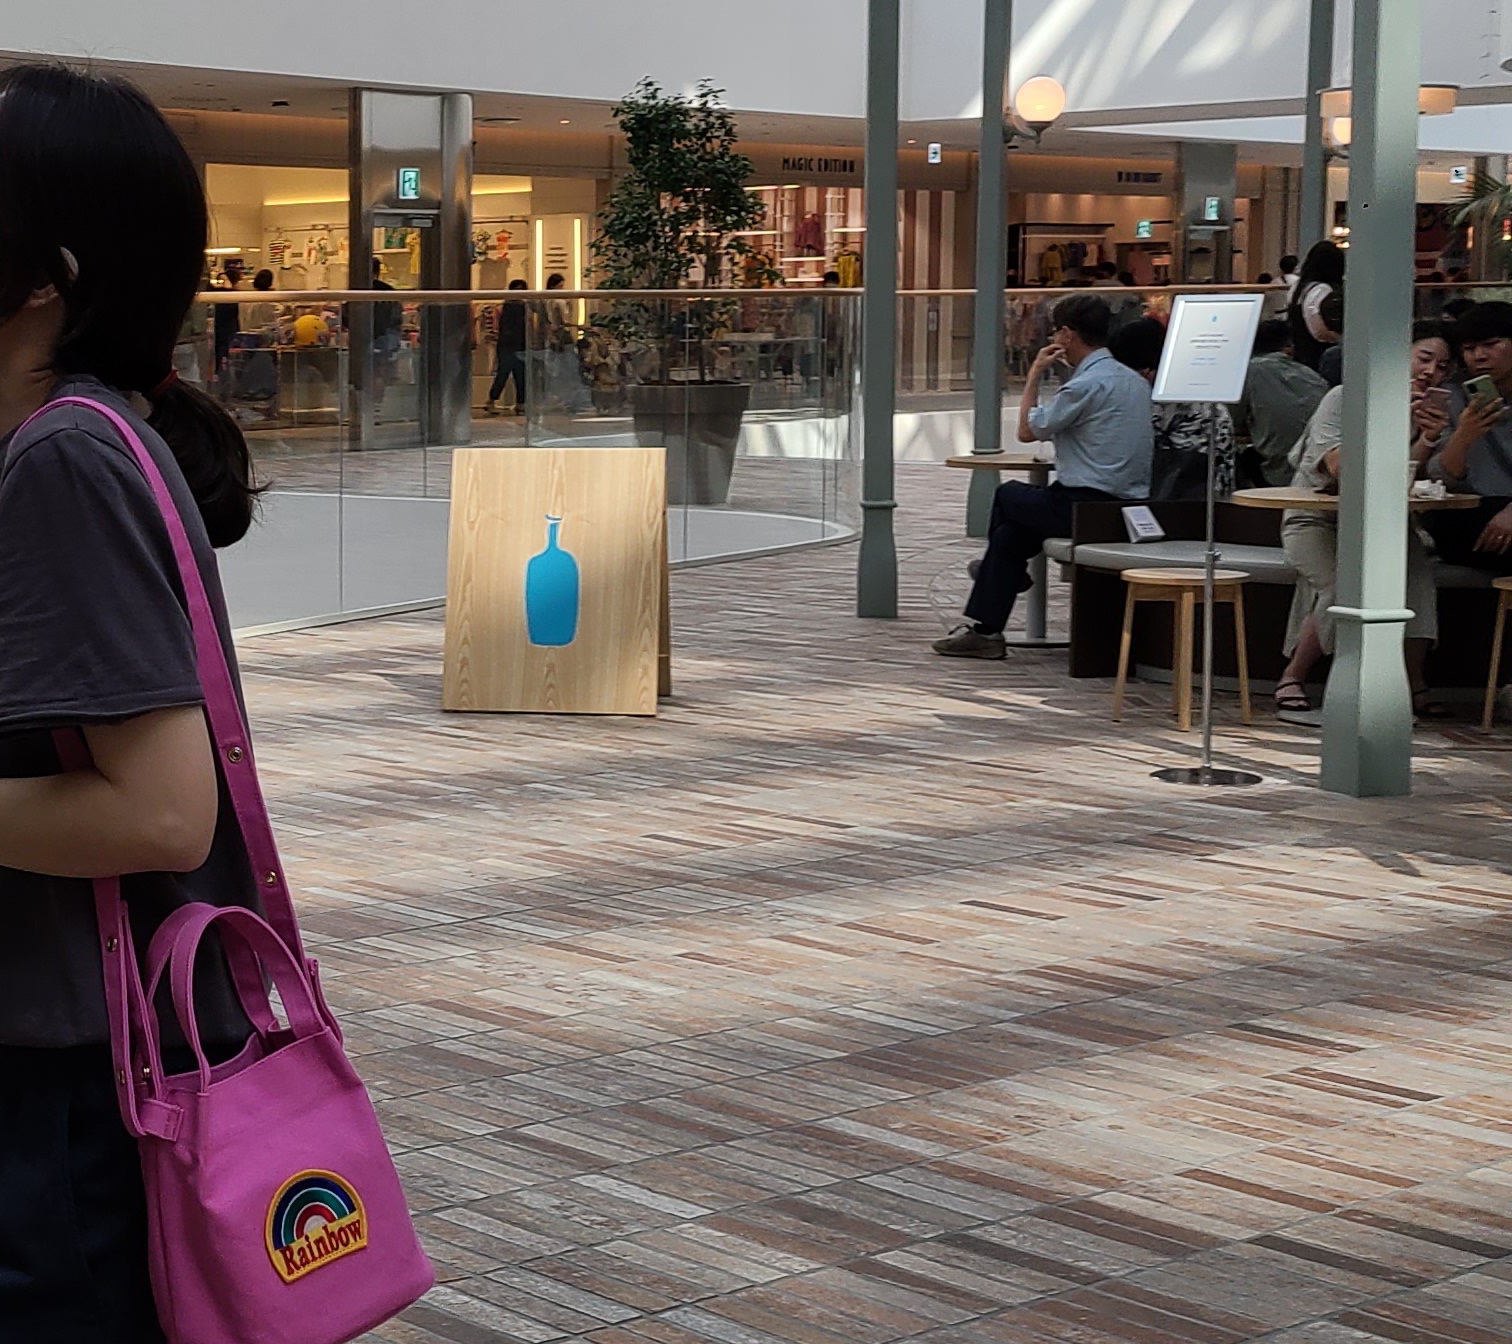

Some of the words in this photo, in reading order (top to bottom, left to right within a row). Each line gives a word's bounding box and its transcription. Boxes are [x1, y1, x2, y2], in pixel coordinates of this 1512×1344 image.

[782, 157, 814, 171] MAGIC
[817, 158, 855, 172] EDITION
[279, 1219, 363, 1275] Rainbow
